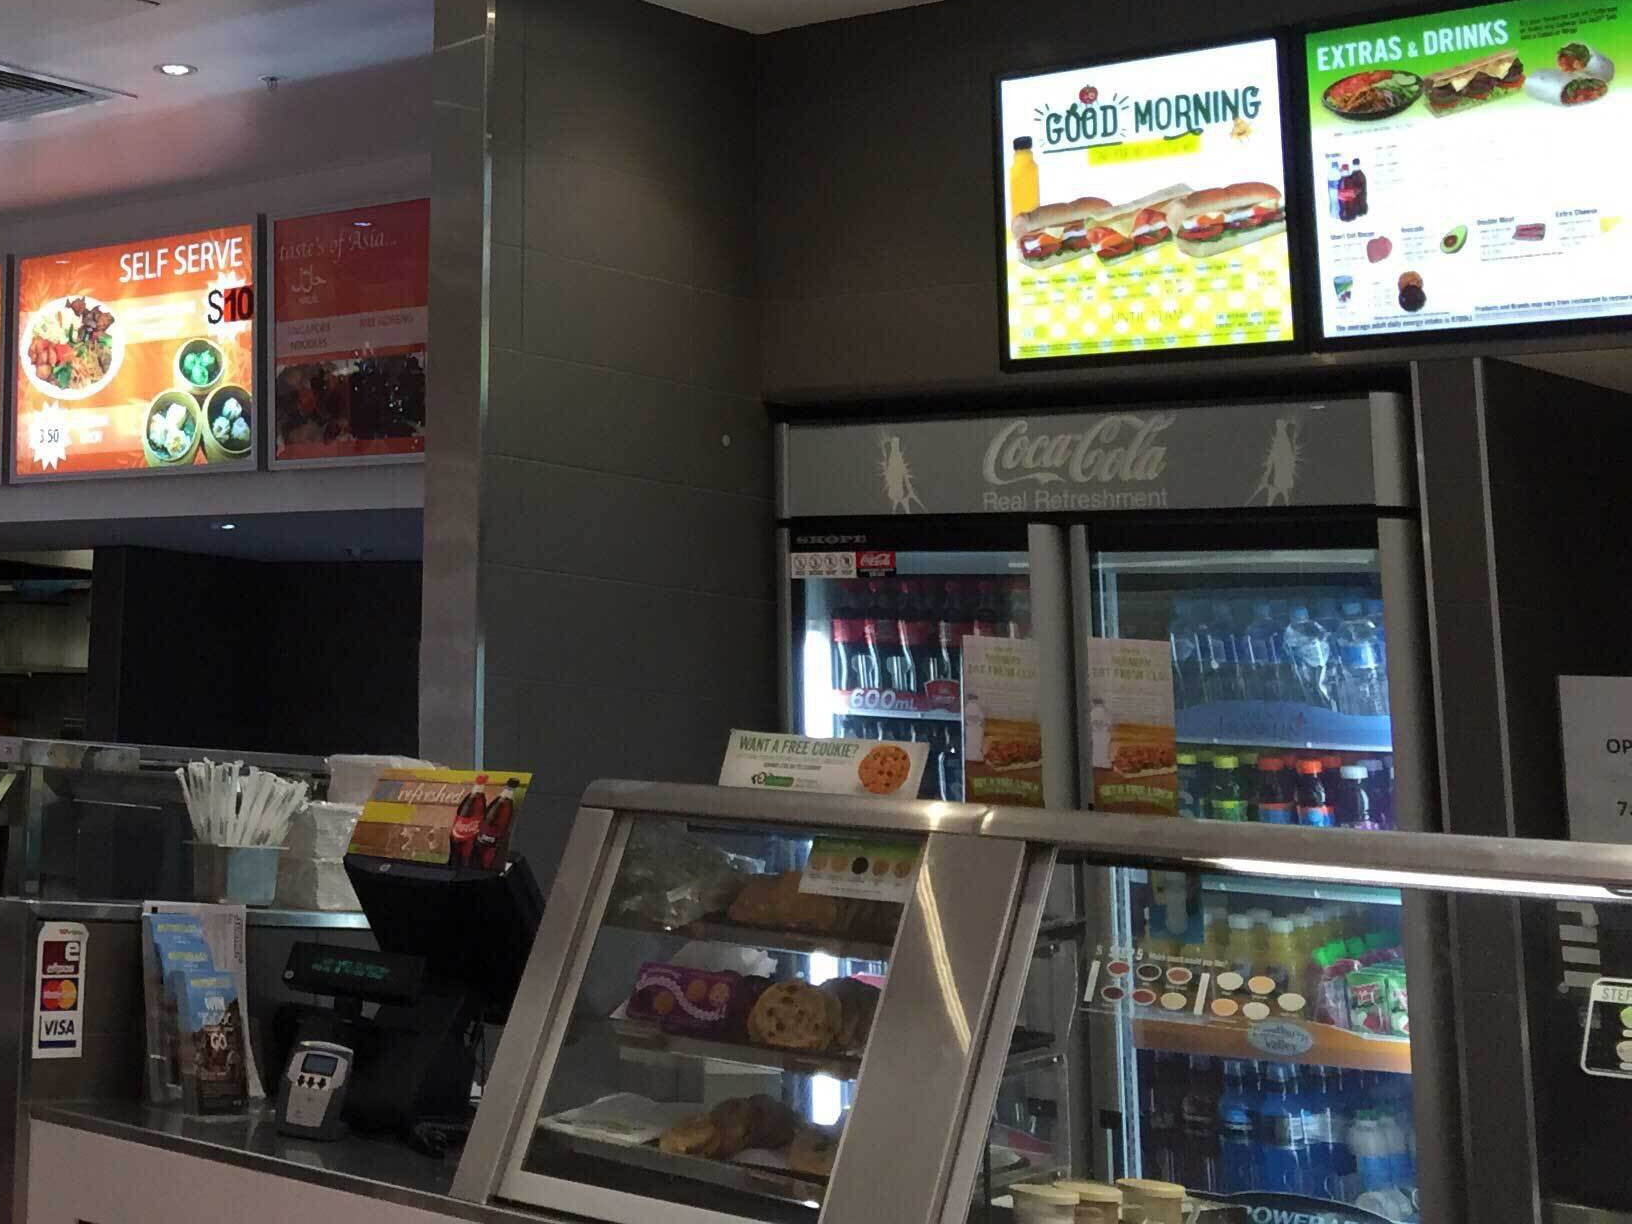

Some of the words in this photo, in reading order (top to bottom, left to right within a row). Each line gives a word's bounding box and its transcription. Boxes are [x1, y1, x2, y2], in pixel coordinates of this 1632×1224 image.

[1316, 35, 1403, 73] EXTRAS
[1407, 40, 1419, 59] &
[1422, 18, 1510, 57] DRINKS
[1045, 102, 1119, 145] GOOD
[1133, 85, 1262, 138] MORNING
[119, 248, 170, 284] SELF
[173, 237, 244, 276] SERVE
[981, 413, 1177, 486] Coca-Cola
[982, 491, 1028, 512] Real
[1034, 487, 1169, 510] Refreshment
[738, 735, 771, 753] WANT
[771, 739, 780, 753] A
[781, 739, 810, 755] FREE
[811, 741, 860, 758] COOKIE?
[44, 1019, 75, 1036] VISA
